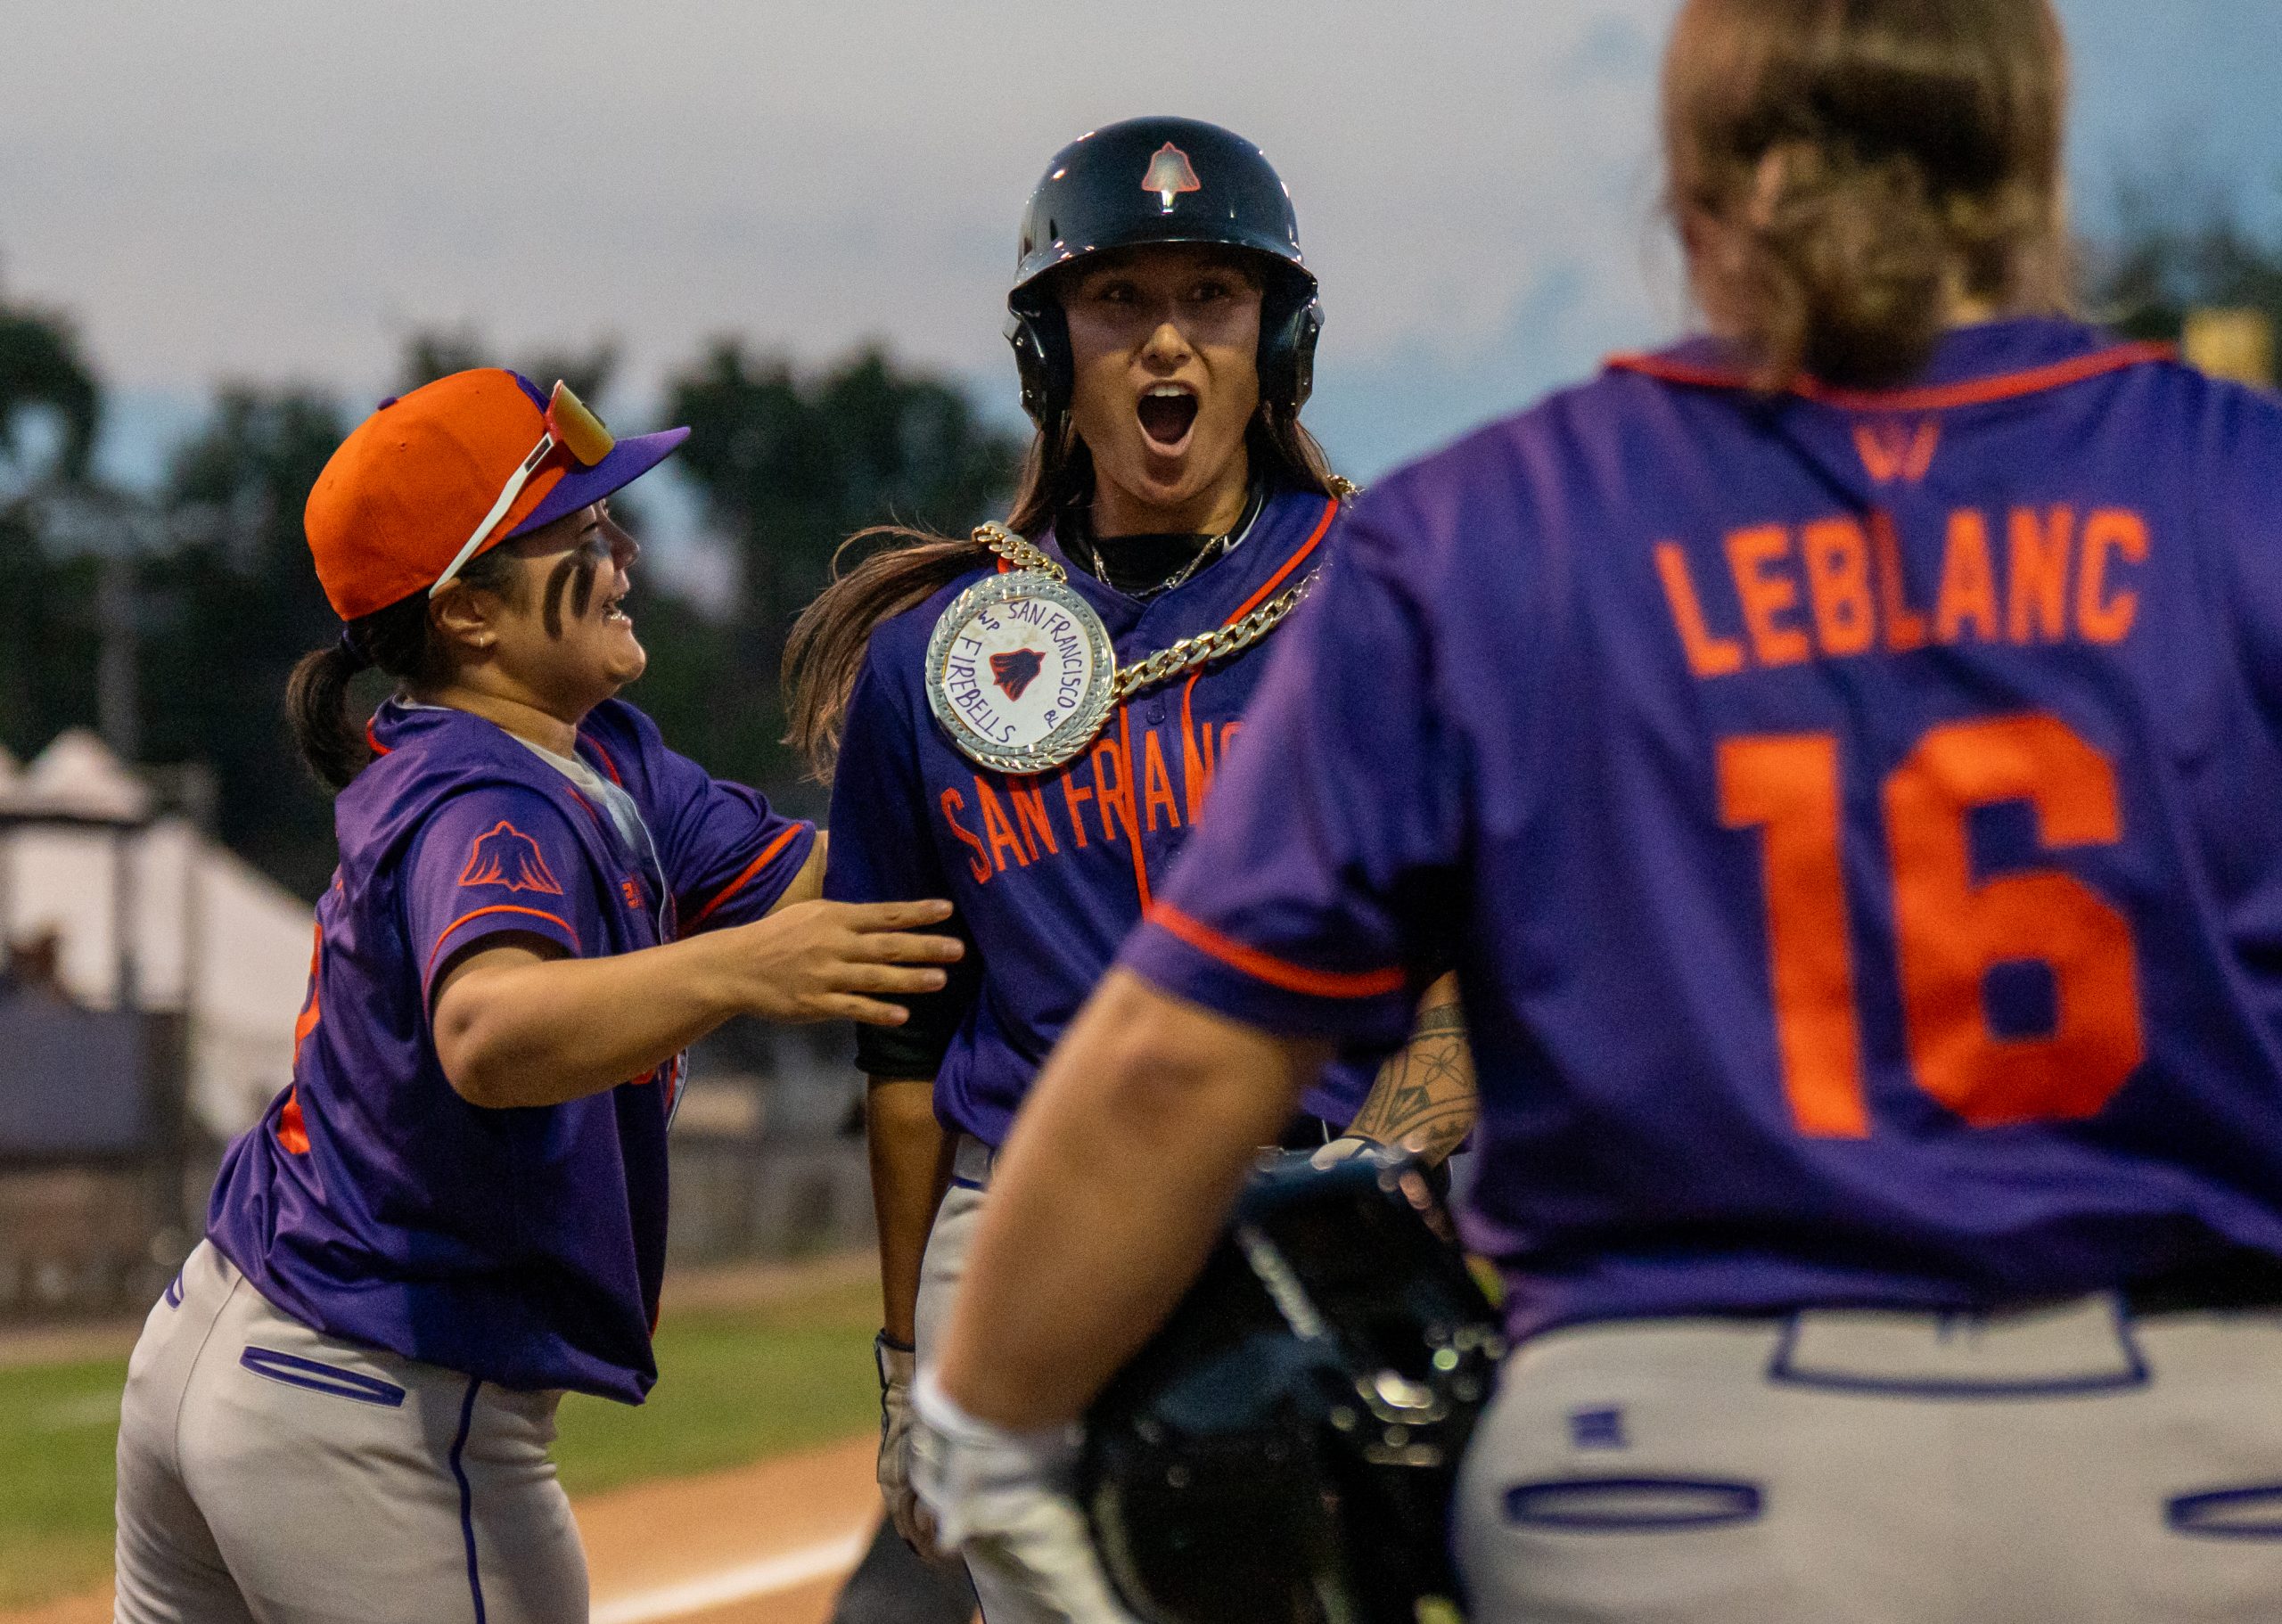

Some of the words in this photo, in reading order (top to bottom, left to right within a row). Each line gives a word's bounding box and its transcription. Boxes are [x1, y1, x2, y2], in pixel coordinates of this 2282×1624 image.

[1008, 601, 1047, 626] SAN
[1041, 612, 1083, 709] FRANCISCO
[1654, 503, 2149, 677] LEBLANC
[947, 636, 1016, 742] FIREBELLS
[940, 774, 1058, 883] SAN
[1060, 722, 1244, 848] FRAN
[1717, 711, 2145, 1139] 16
